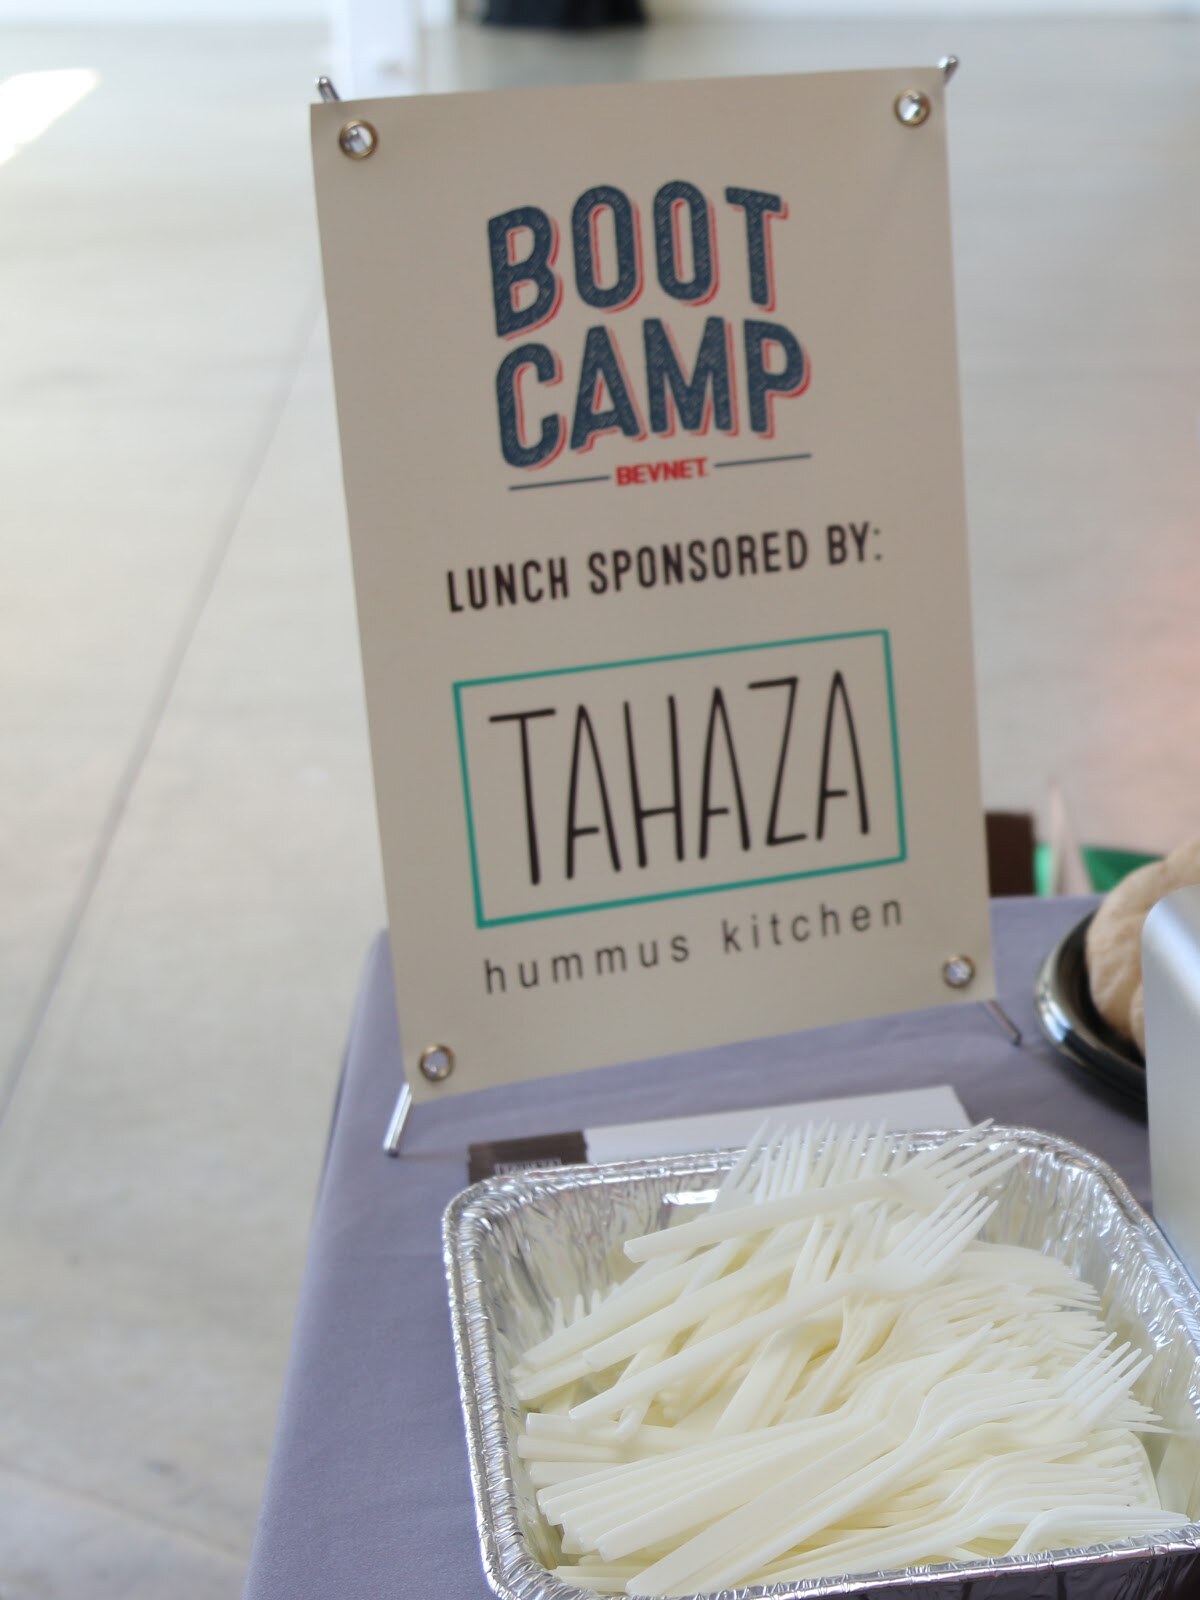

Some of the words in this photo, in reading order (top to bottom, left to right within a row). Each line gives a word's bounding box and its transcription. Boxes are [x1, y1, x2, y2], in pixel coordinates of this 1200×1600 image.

[487, 180, 788, 341] BOOT
[495, 316, 811, 471] CAMP
[615, 457, 708, 486] BEVNET
[446, 556, 570, 612] LUNCH
[588, 529, 808, 595] SPONSORED
[826, 522, 883, 566] BY:
[489, 670, 870, 886] TAHAZA
[484, 932, 690, 994] hummus
[721, 898, 903, 955] kitchen
